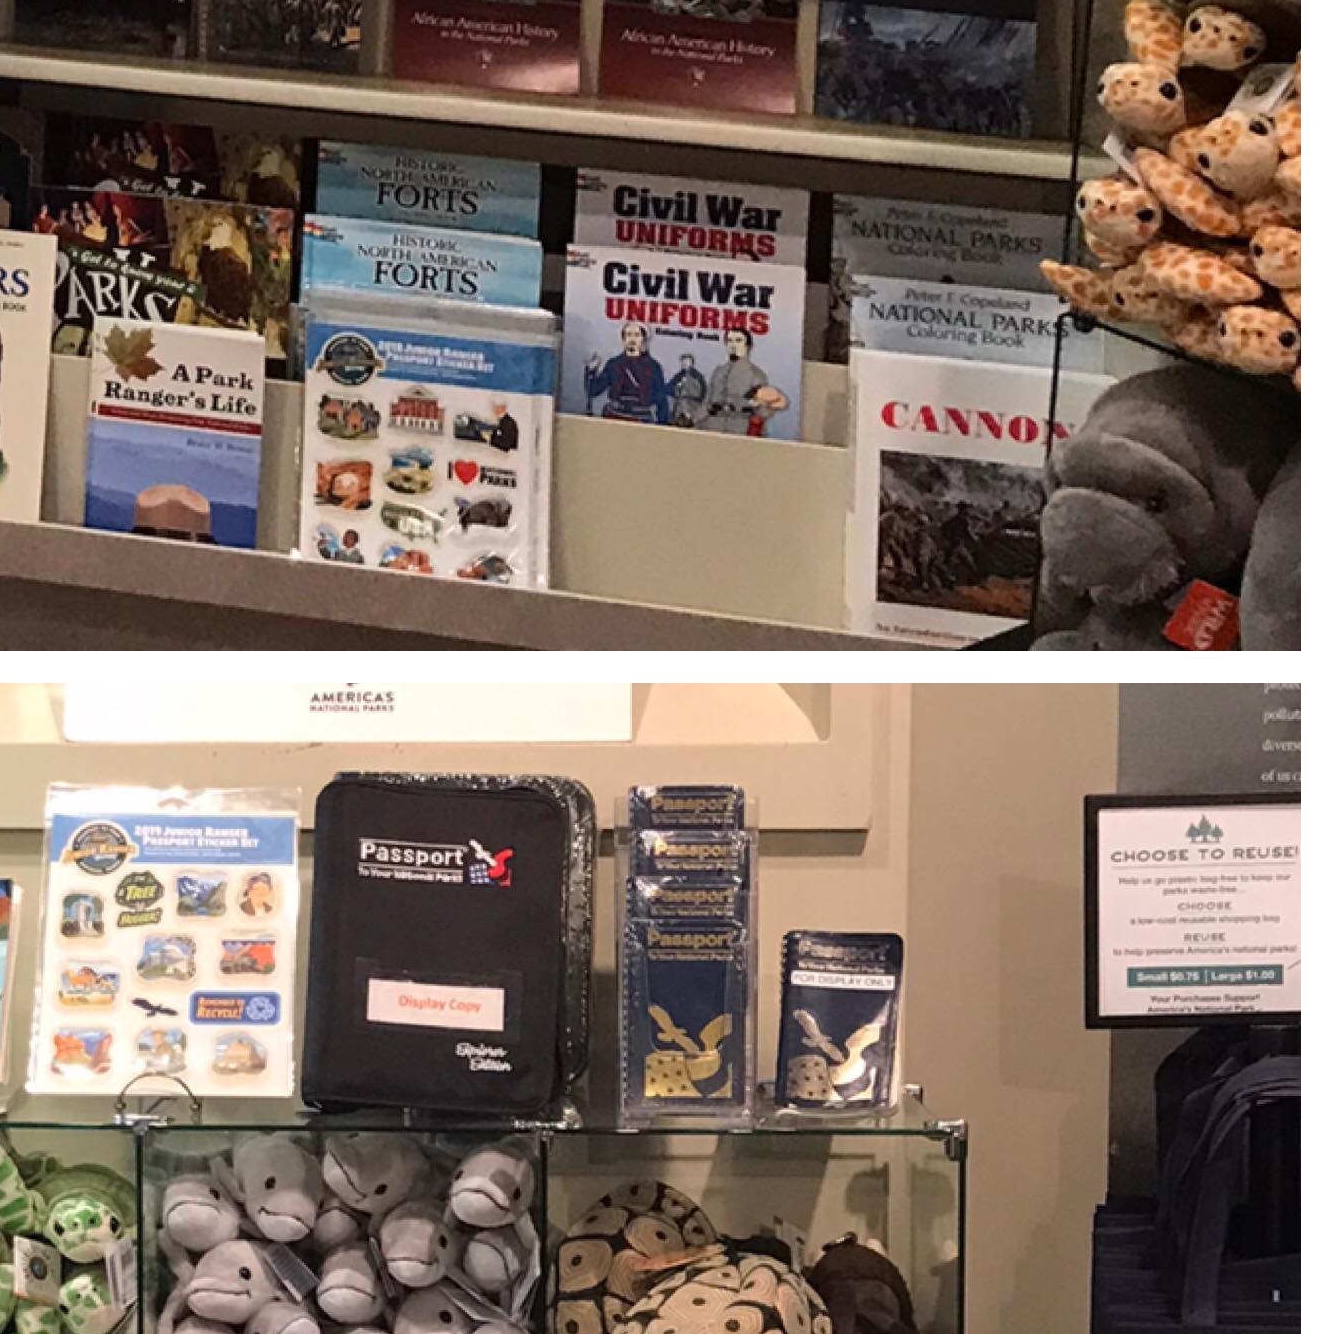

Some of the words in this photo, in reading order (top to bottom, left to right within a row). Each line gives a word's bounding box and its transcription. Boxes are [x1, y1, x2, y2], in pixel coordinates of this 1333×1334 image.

[376, 185, 479, 215] FORTS
[613, 185, 687, 224] Civil
[698, 191, 782, 232] War
[615, 219, 776, 257] UNIFORMS
[851, 220, 964, 248] NATIONAL
[972, 231, 1043, 253] PARKS
[372, 262, 479, 295] FORTS
[602, 261, 689, 300] Civil
[698, 270, 774, 309] War
[605, 296, 771, 335] UNIFORMS
[869, 302, 980, 330] NATIONAL
[990, 314, 1070, 339] PARKS
[907, 323, 975, 345] Coloring
[982, 330, 1025, 348] Book
[171, 364, 190, 382] A
[194, 366, 253, 392] Park
[103, 380, 206, 411] Ranger's
[211, 391, 257, 417] Life
[310, 704, 359, 713] NATIONAL
[362, 704, 395, 713] PARKS
[311, 691, 396, 704] AMERICA'S
[361, 841, 464, 867] Passport
[1110, 848, 1189, 863] CHOOSE
[1198, 848, 1224, 860] TO
[1233, 846, 1299, 859] REUSE!
[1177, 902, 1232, 911] CHOOSE
[647, 928, 733, 949] Passport
[1184, 933, 1226, 942] REUSE
[793, 974, 815, 984] FOR
[818, 974, 862, 985] DISPLAY
[865, 976, 893, 987] ONLY
[1136, 972, 1168, 982] Small
[1211, 971, 1244, 982] Large
[1246, 970, 1275, 981] $1.00
[398, 992, 445, 1013] Display
[449, 997, 482, 1017] Copy
[1150, 994, 1170, 1004] Your
[1173, 994, 1222, 1004] Purchases
[1224, 994, 1260, 1003] Support
